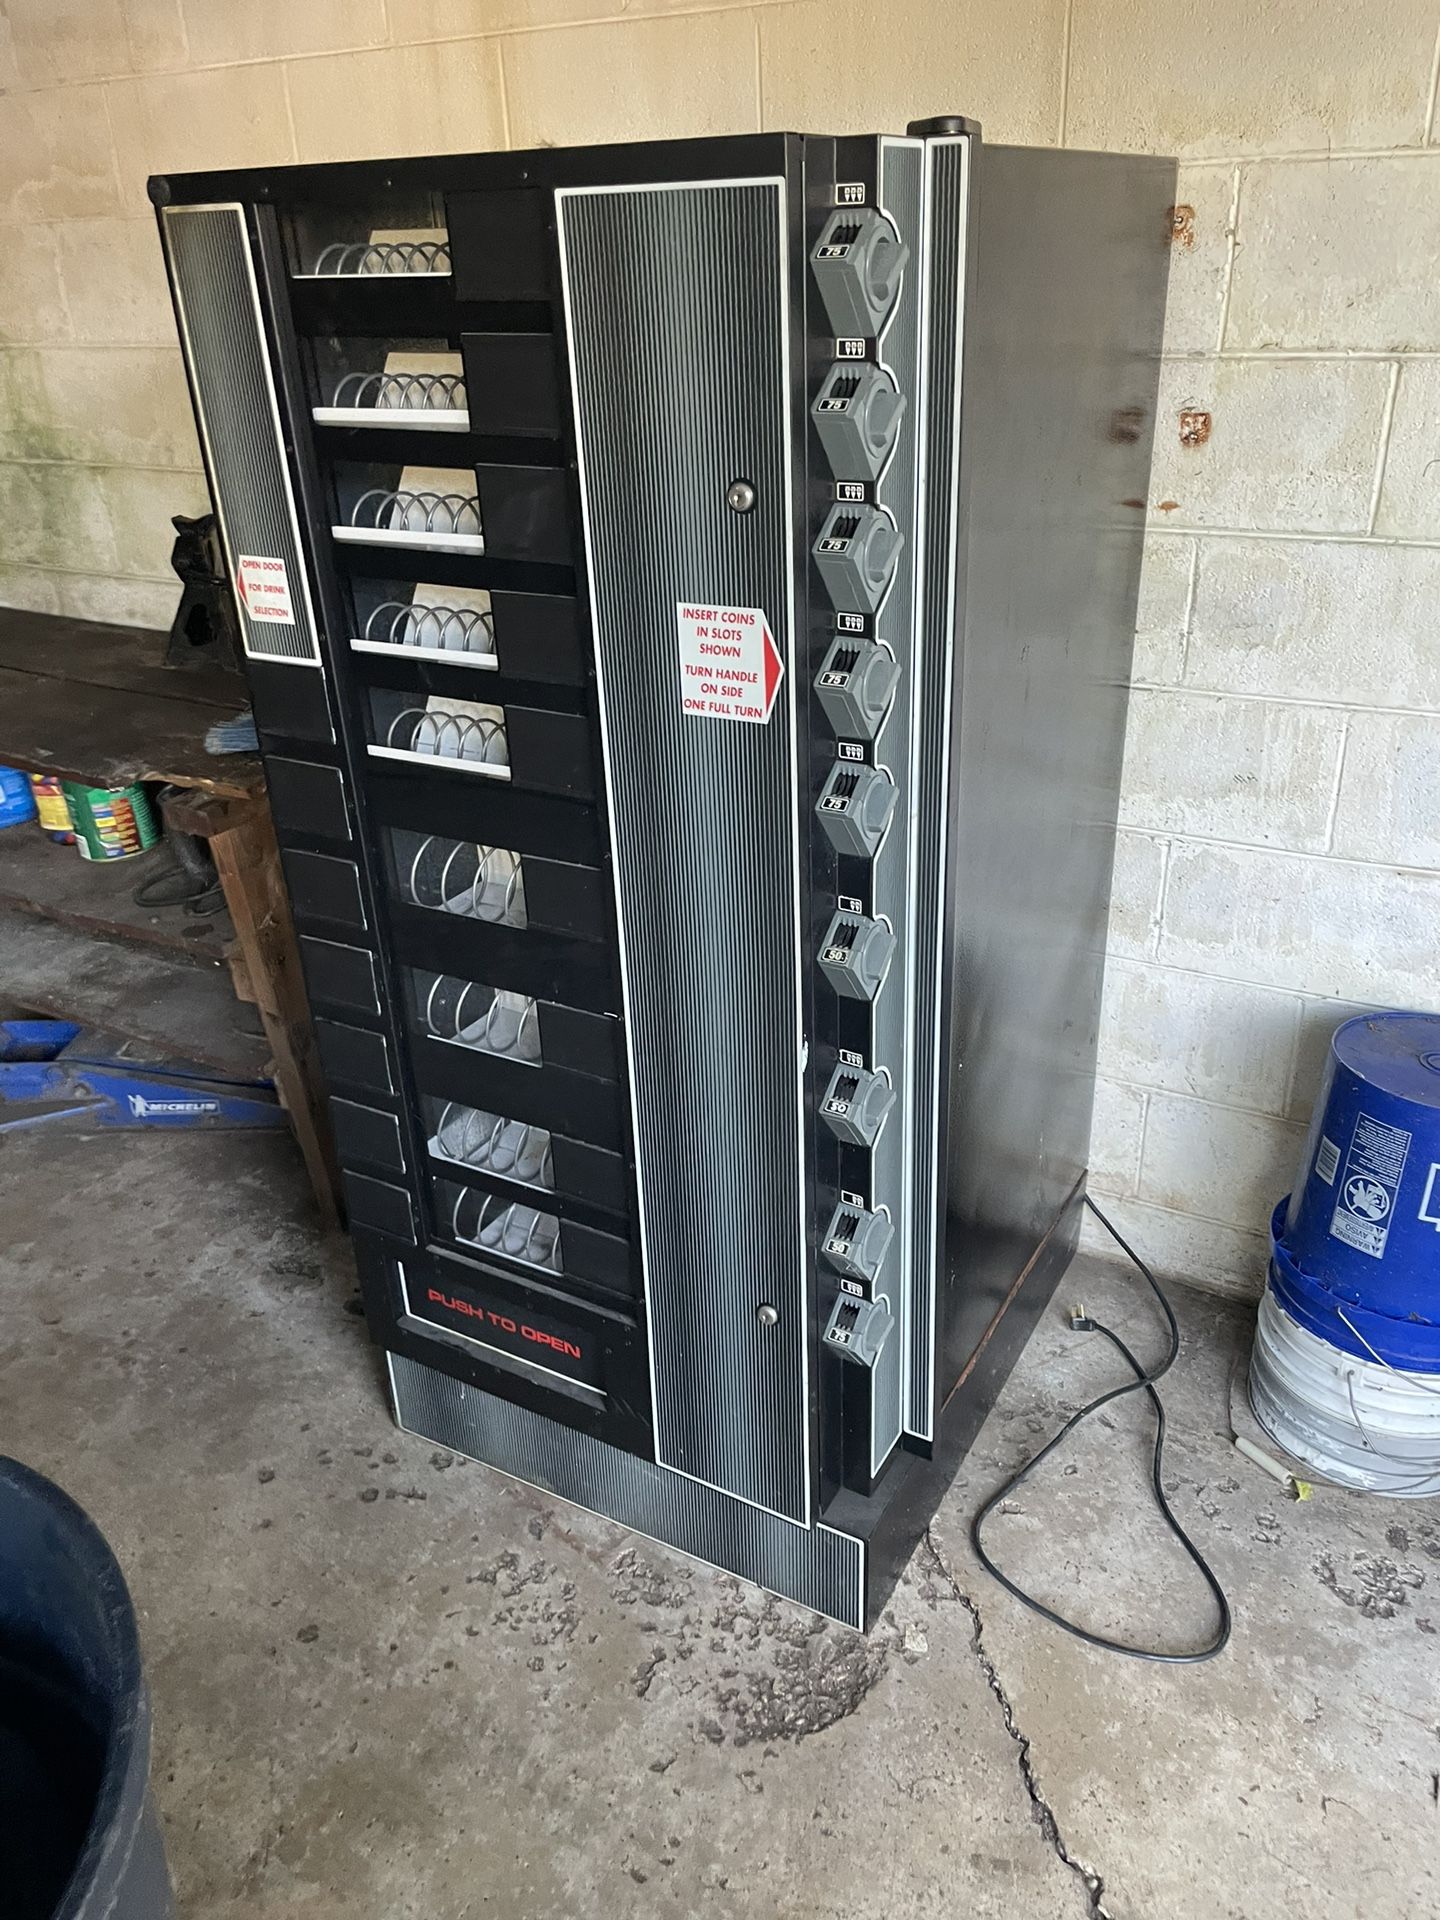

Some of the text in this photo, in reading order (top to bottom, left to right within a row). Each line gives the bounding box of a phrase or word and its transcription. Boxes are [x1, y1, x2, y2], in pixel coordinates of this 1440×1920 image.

[826, 247, 842, 256] 75
[827, 401, 843, 410] 75
[827, 540, 843, 550] 75
[242, 560, 283, 572] OPEN DOOR
[249, 584, 286, 594] FOR DRINK
[254, 606, 289, 617] SELECTION
[683, 608, 755, 625] INSERT COINS
[697, 626, 742, 641] IN SLOTS
[700, 643, 741, 658] SHOWN
[685, 665, 758, 683] TURN HANDLE
[828, 674, 842, 684] 75
[701, 683, 743, 697] ON SIDE
[684, 698, 763, 718] ONE FULL TURN
[828, 799, 842, 809] 75
[150, 1103, 216, 1111] MICHELIN
[1345, 1224, 1368, 1239] AVISO
[1335, 1228, 1371, 1251] WARNING
[428, 1288, 582, 1359] PUSH TO OPEN
[834, 1331, 847, 1342] 75
